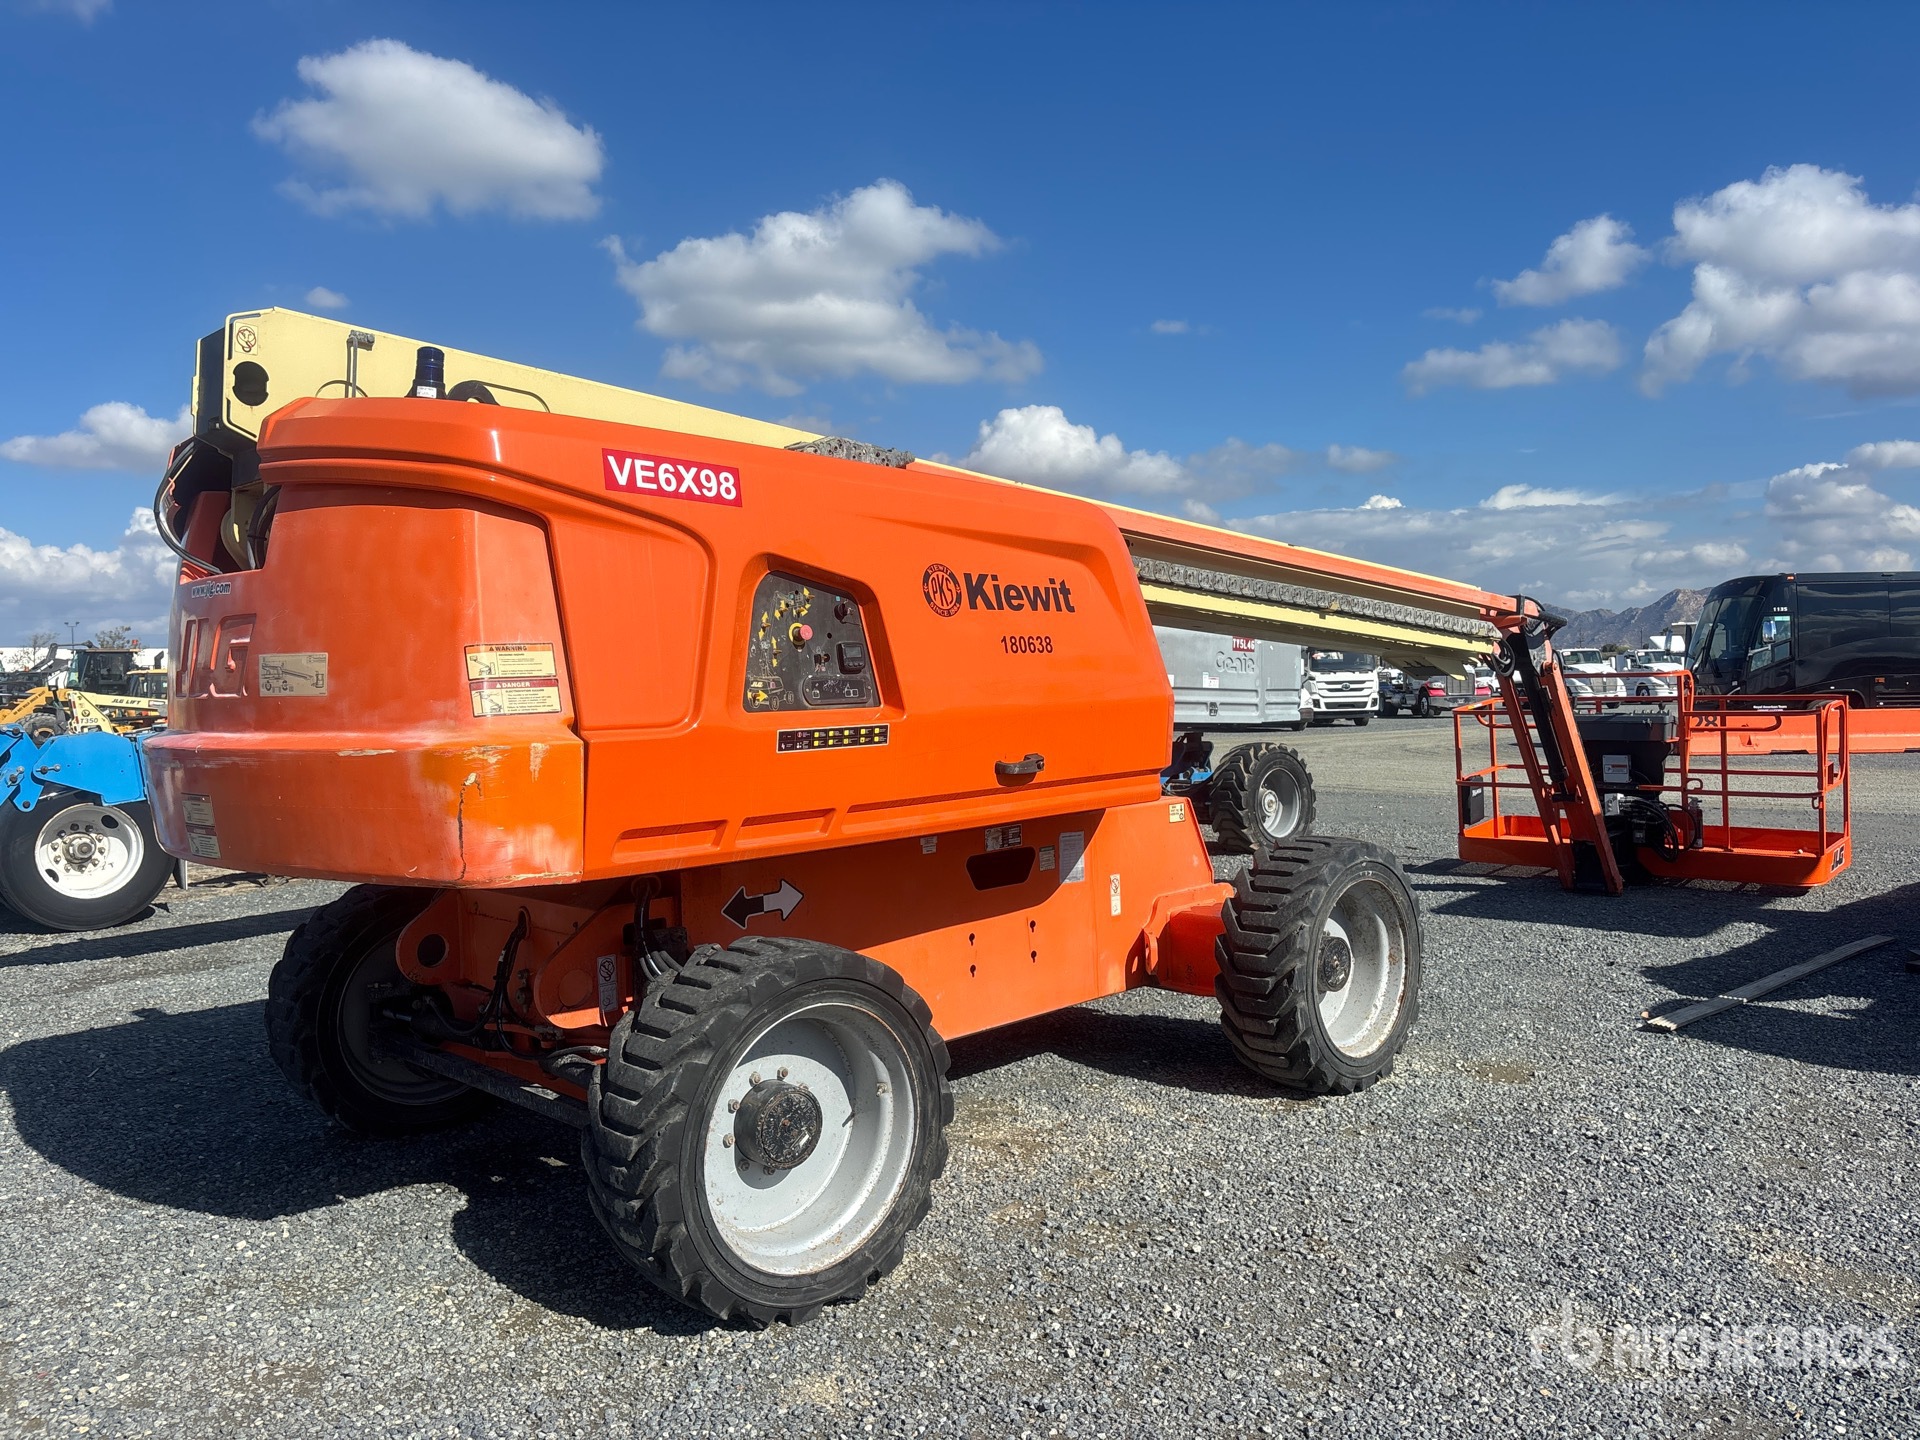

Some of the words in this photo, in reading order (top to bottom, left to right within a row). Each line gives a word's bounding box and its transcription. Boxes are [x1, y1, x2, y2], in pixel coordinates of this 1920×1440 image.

[606, 455, 737, 500] VE6X98
[927, 564, 952, 576] KIEWIT
[191, 581, 232, 599] www.jlg.com
[930, 574, 954, 607] PKS
[963, 572, 1076, 613] Kiewit
[929, 601, 950, 617] SINCE
[1000, 635, 1054, 654] 180638
[1216, 650, 1256, 674] Genie
[502, 681, 531, 689] DANGER
[1831, 844, 1846, 873] JLG
